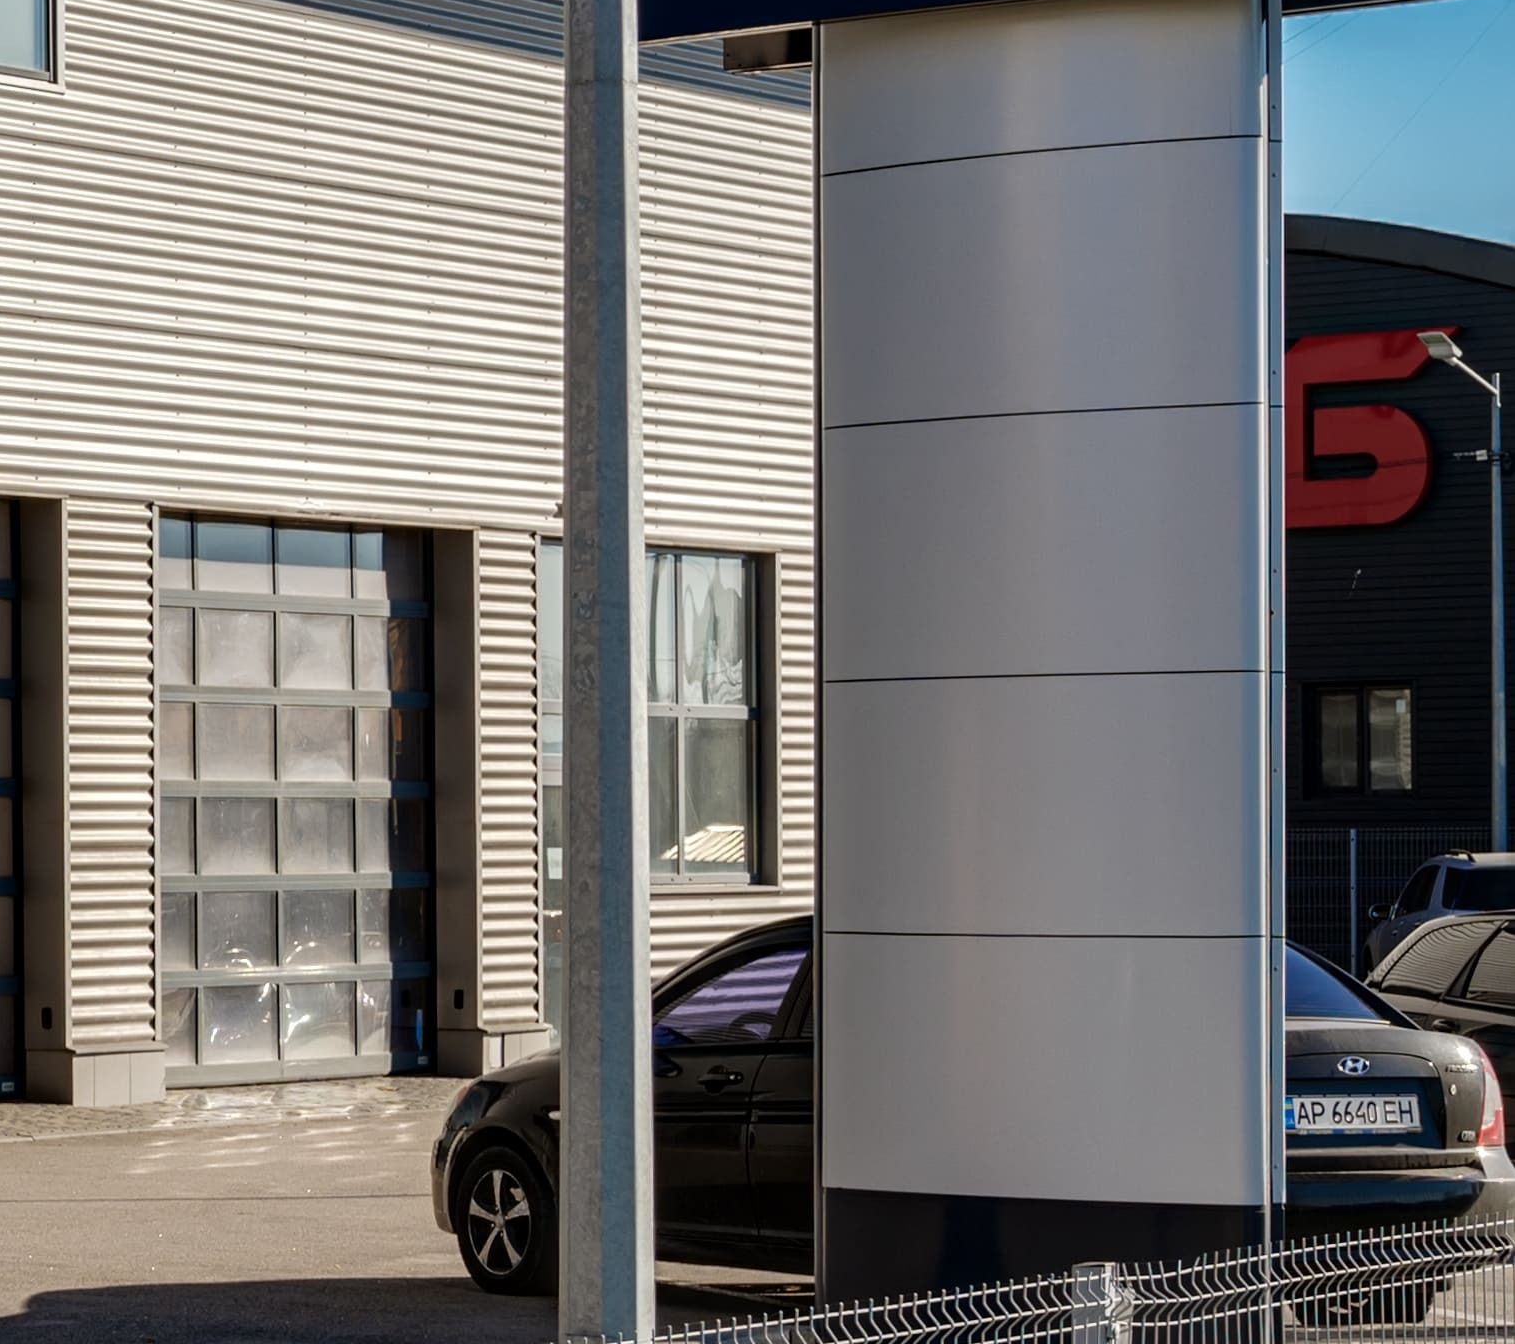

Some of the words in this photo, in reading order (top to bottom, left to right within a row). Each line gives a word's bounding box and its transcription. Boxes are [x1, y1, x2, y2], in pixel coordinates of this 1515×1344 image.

[1297, 1101, 1325, 1125] AP
[1332, 1100, 1378, 1124] 6640
[1384, 1100, 1414, 1124] EH
